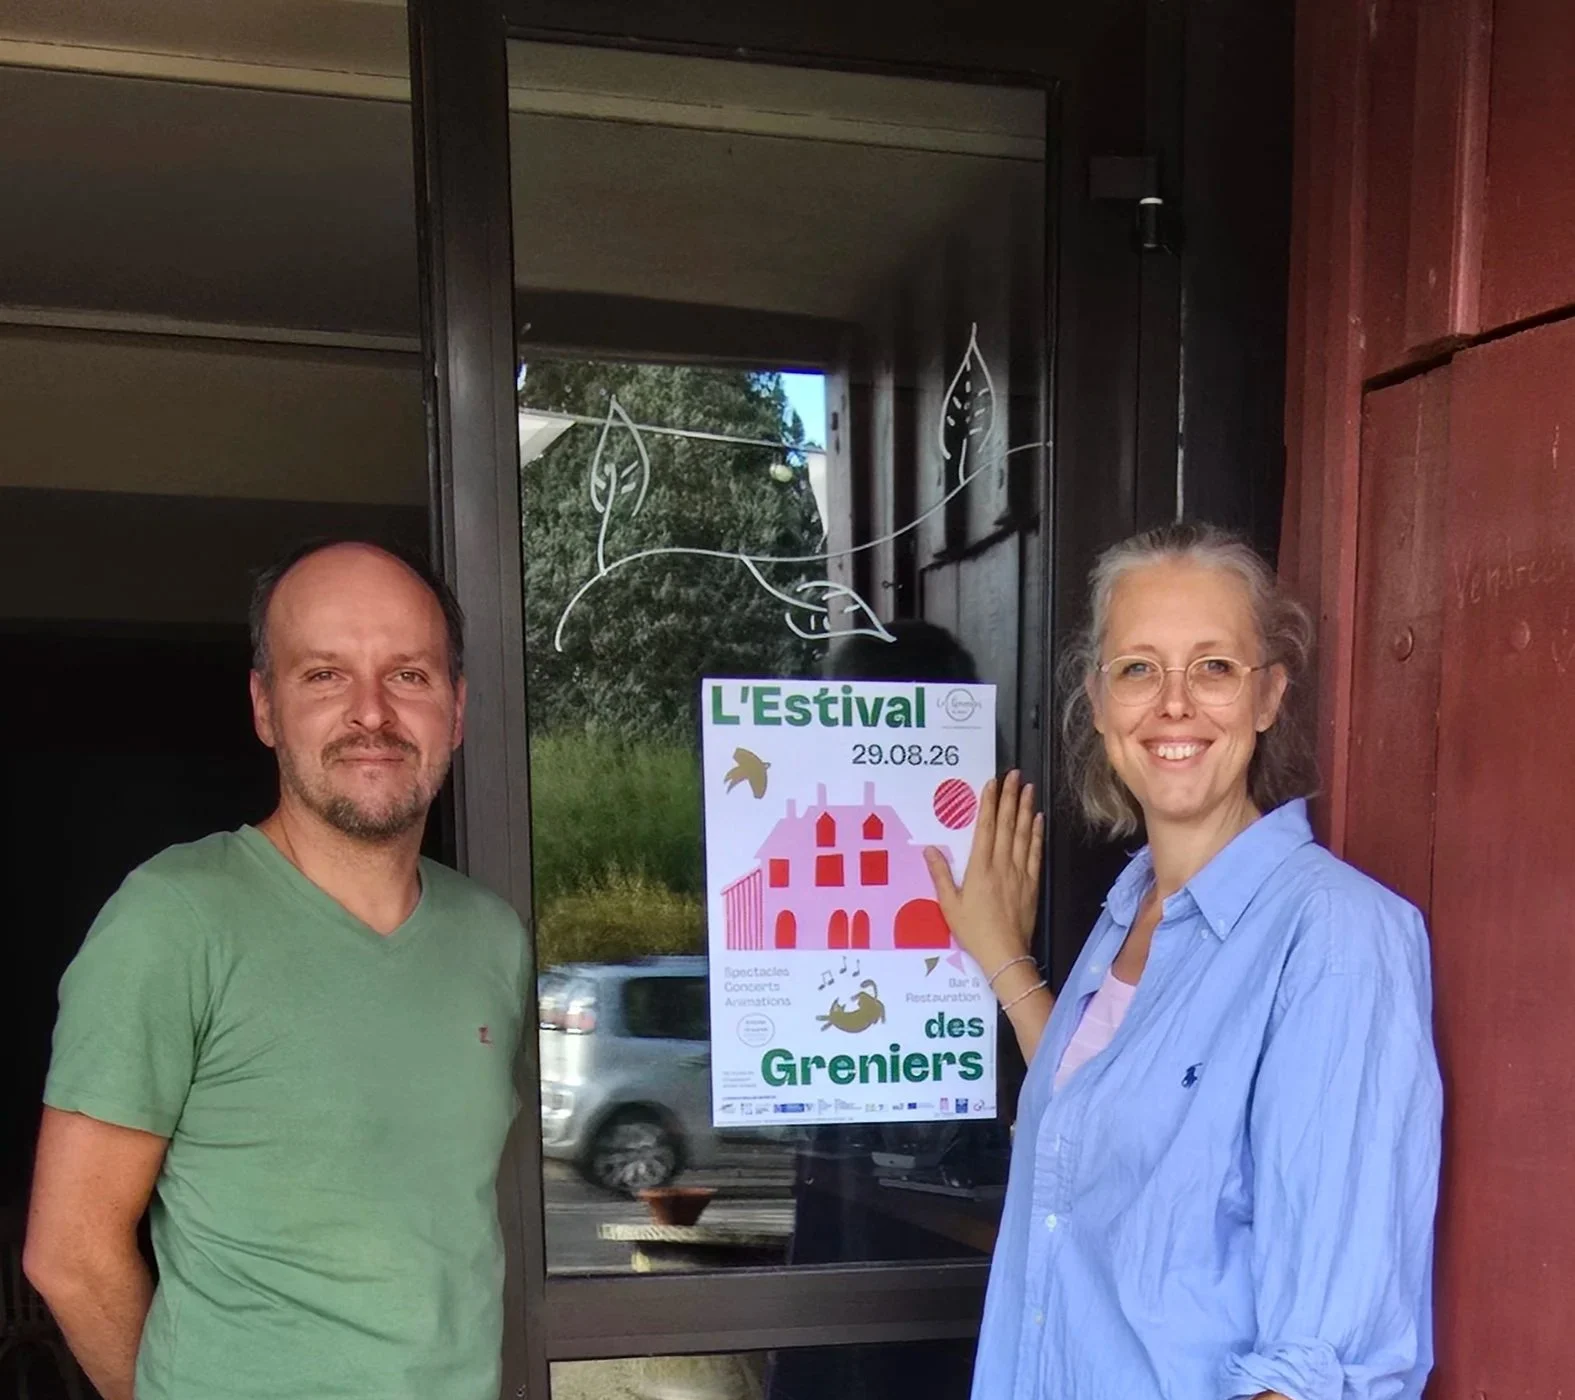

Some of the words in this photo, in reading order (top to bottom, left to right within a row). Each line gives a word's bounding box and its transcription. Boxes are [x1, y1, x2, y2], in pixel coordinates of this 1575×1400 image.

[711, 684, 927, 728] L'Estival
[852, 744, 960, 766] 29.08.26
[724, 967, 791, 980] Spectacles
[724, 981, 781, 993] Concerts
[949, 978, 970, 988] Bar
[724, 996, 792, 1008] Animations
[905, 992, 981, 1003] Restauration
[924, 1012, 985, 1039] des
[760, 1043, 984, 1087] Greniers
